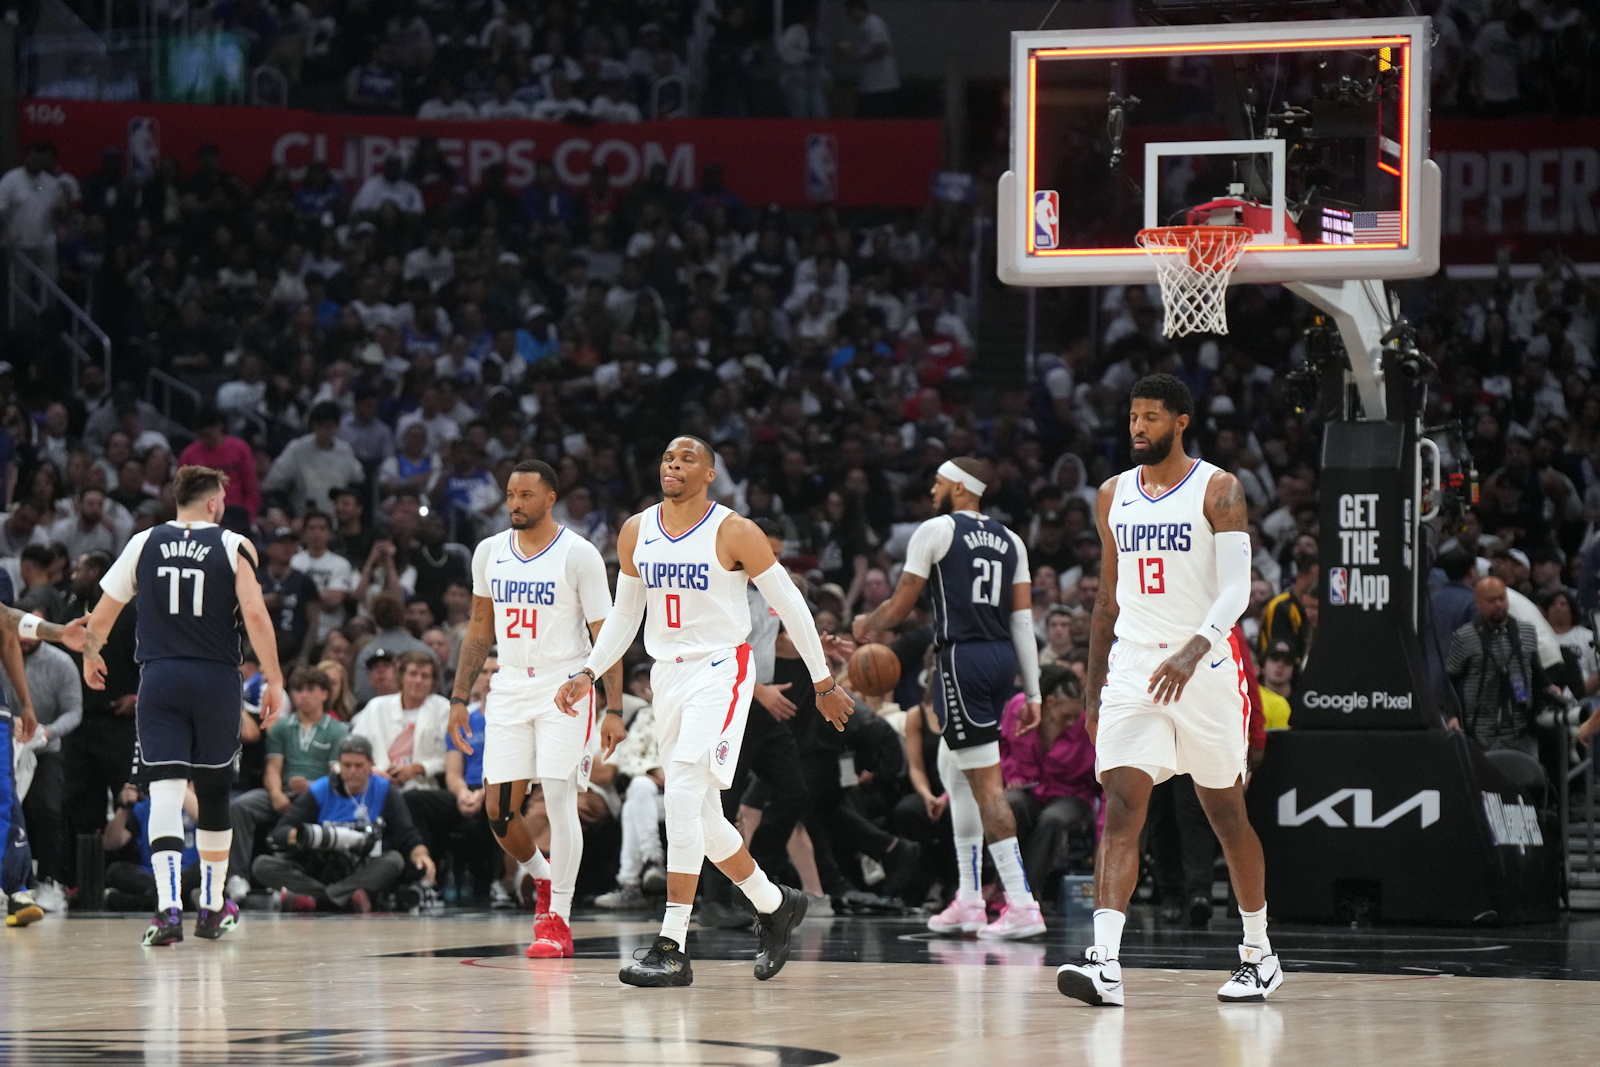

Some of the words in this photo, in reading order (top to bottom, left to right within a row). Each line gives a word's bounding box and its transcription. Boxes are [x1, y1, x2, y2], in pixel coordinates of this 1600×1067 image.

[1338, 493, 1380, 529] GET
[963, 530, 1009, 555] GAFFORD
[1115, 523, 1192, 552] CLIPPERS
[1338, 530, 1381, 565] THE
[157, 566, 205, 617] 77
[491, 578, 555, 606] CLIPPERS
[972, 557, 1003, 607] 21
[1138, 557, 1165, 595] 13
[1348, 567, 1390, 611] App
[506, 608, 538, 639] 24
[665, 594, 681, 629] 0
[1303, 690, 1369, 713] Google
[1371, 691, 1413, 710] Pixel
[1277, 786, 1440, 829] KIA
